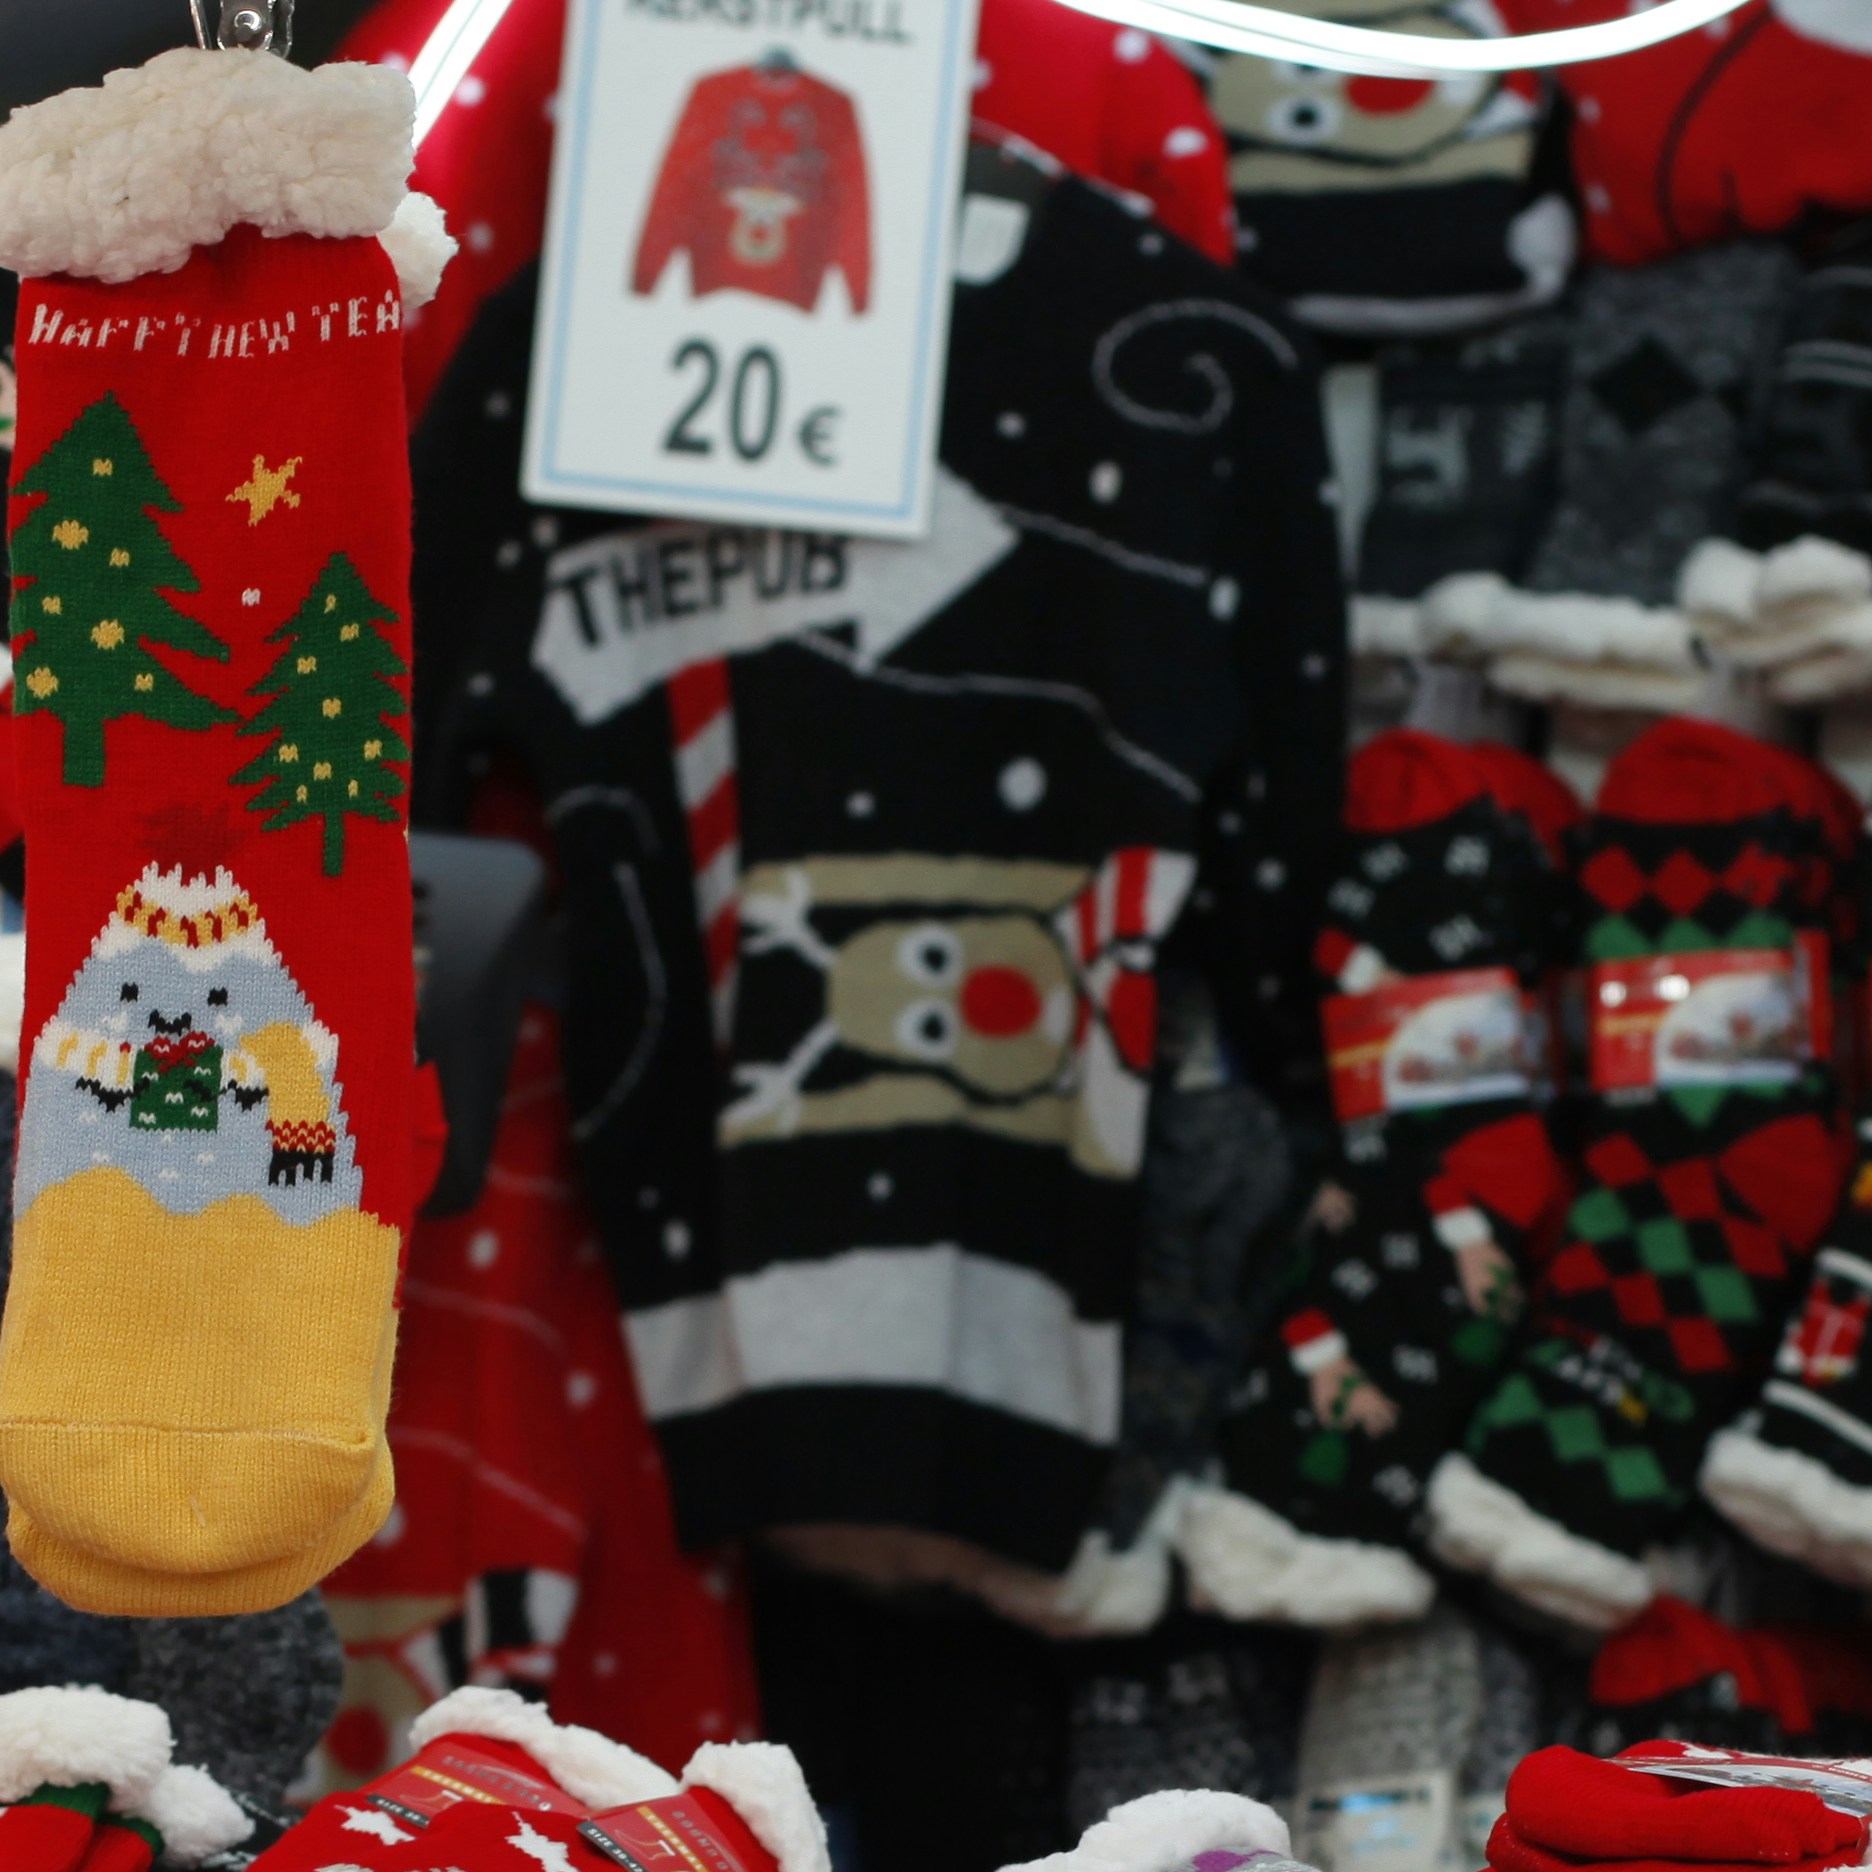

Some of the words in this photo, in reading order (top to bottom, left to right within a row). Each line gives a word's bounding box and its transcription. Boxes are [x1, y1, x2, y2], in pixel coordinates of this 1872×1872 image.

[661, 337, 782, 464] 20
[797, 405, 844, 467] €
[586, 1826, 614, 1849] SIZE
